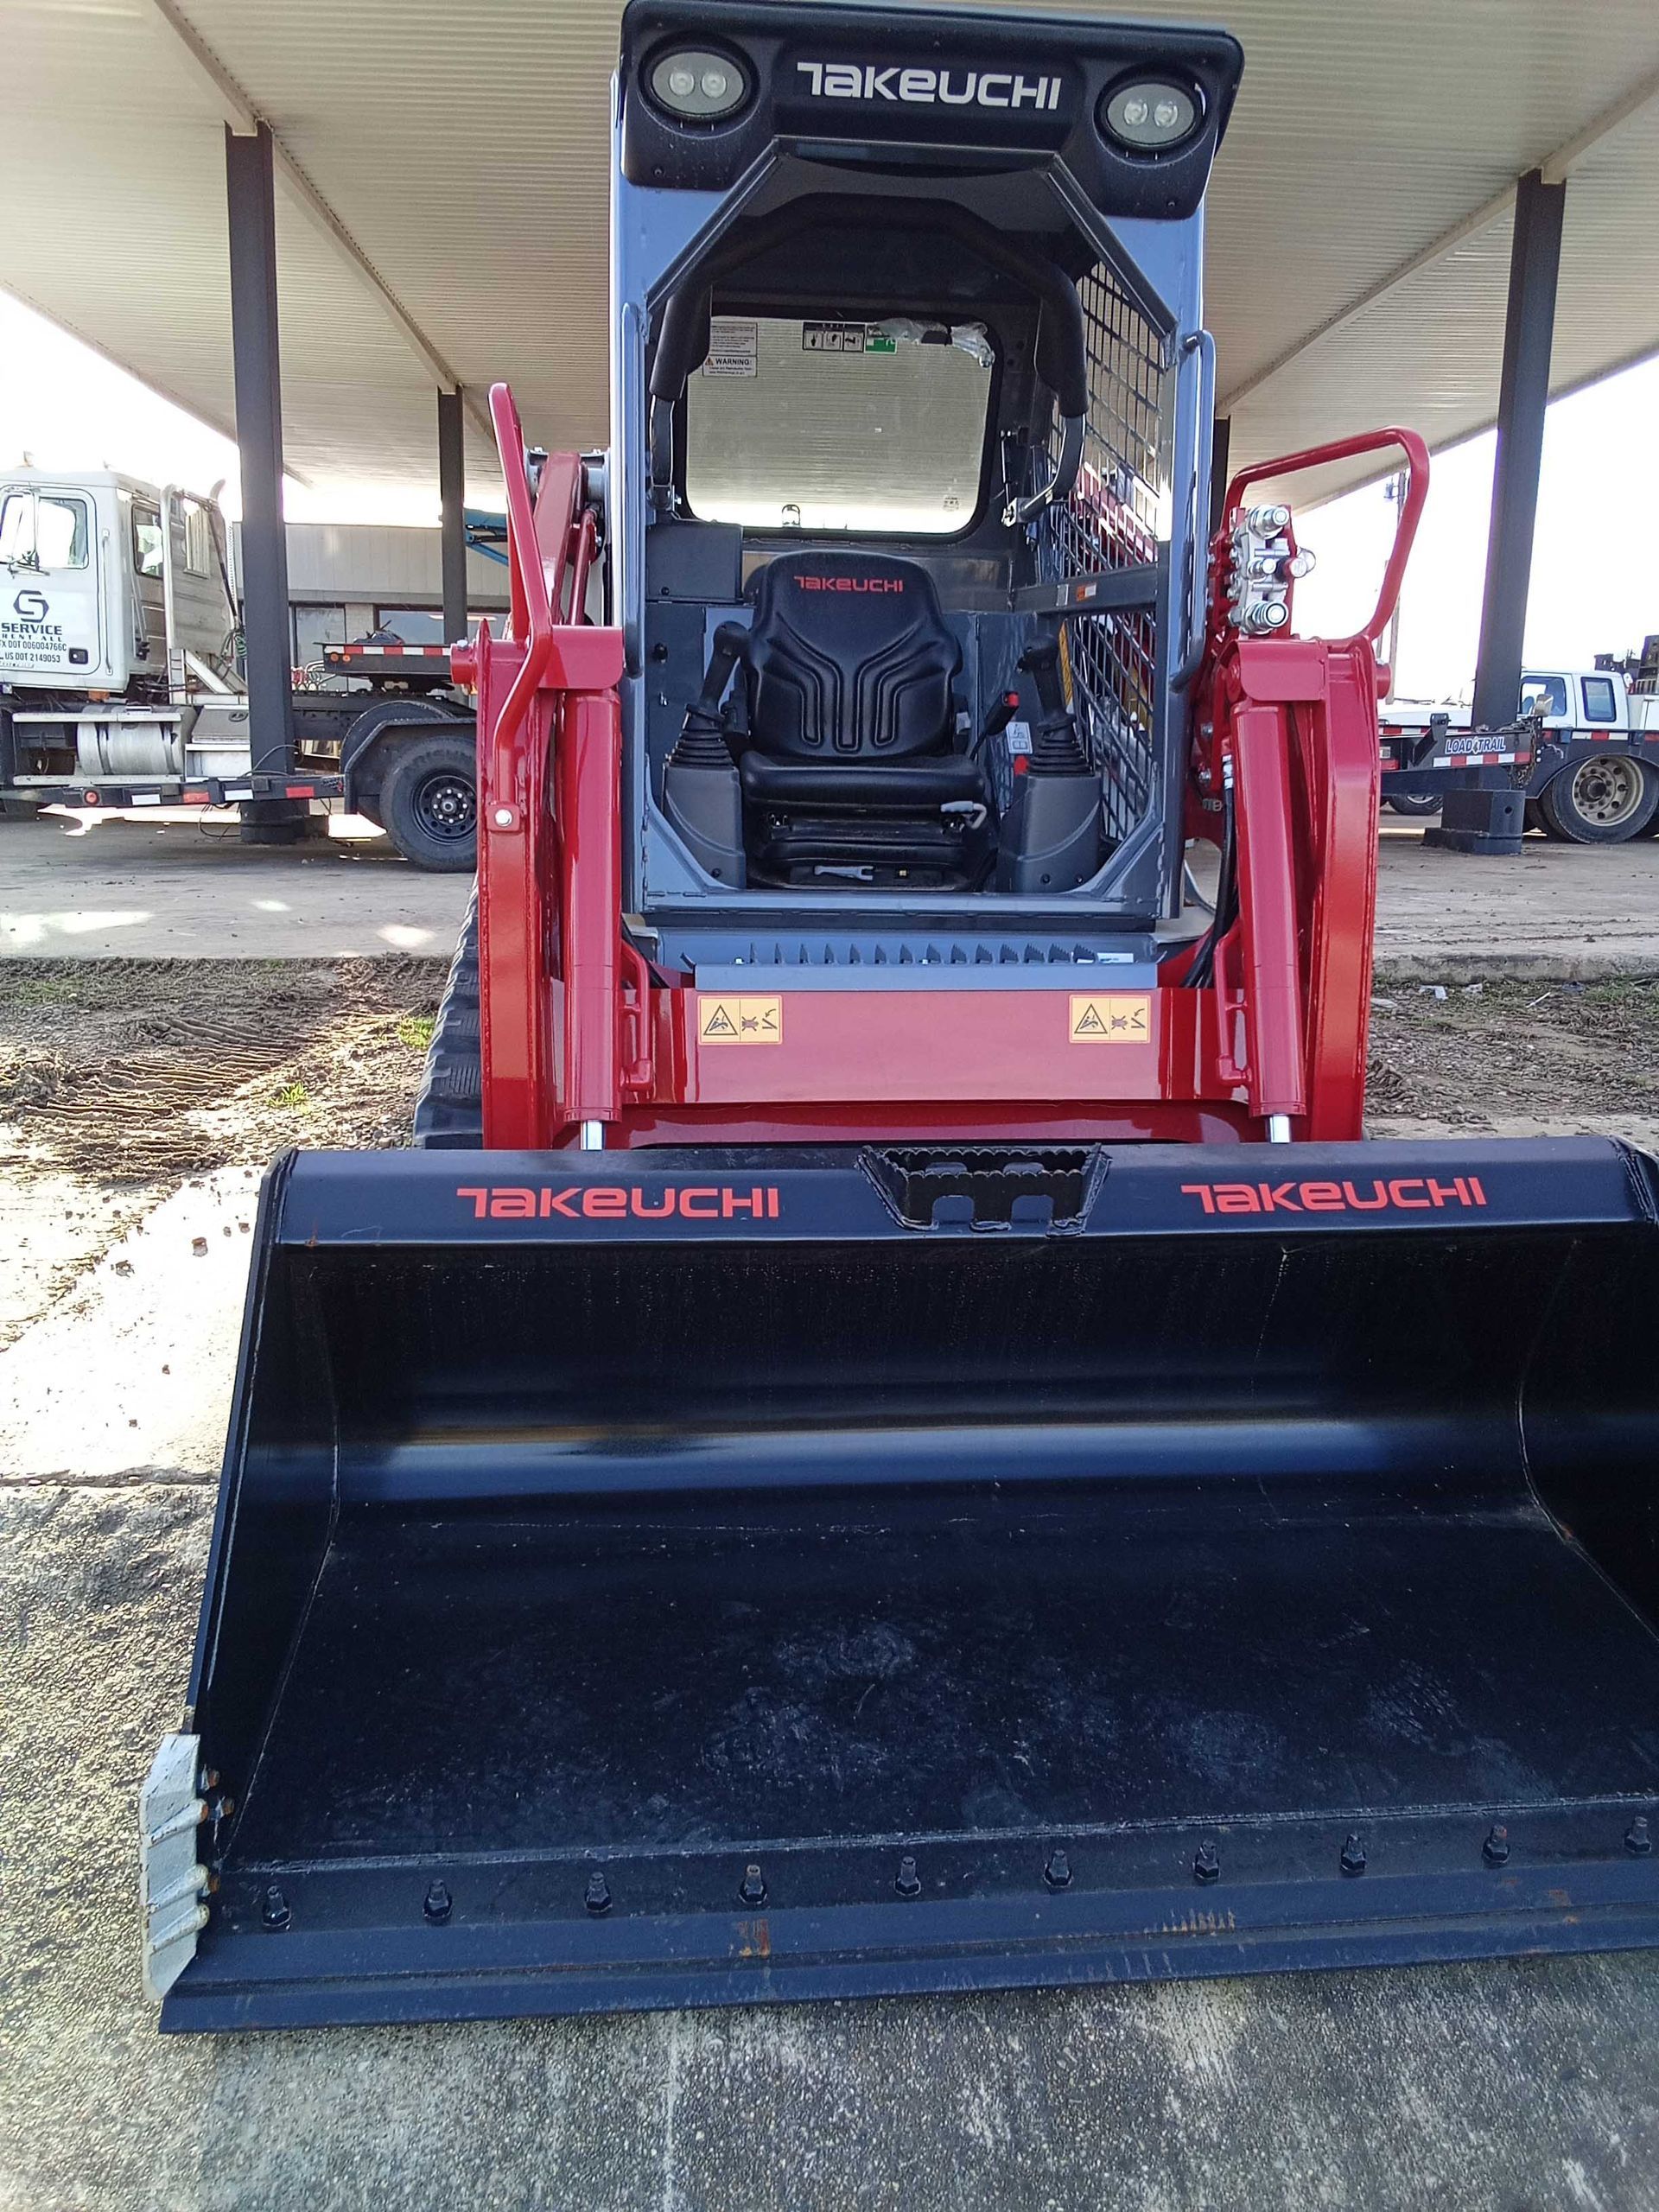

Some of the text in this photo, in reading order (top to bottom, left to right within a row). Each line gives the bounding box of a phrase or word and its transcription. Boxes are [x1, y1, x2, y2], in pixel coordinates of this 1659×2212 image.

[797, 61, 1062, 110] TAKEUCHI
[793, 575, 903, 592] TAKEUCHI
[2, 622, 62, 635] SERVICE
[5, 652, 60, 663] US DOT 2149053
[1445, 736, 1506, 754] LOAD TRAIL
[456, 1187, 779, 1218] TAKEUCHI
[1180, 1177, 1487, 1213] TAKEUCHI
